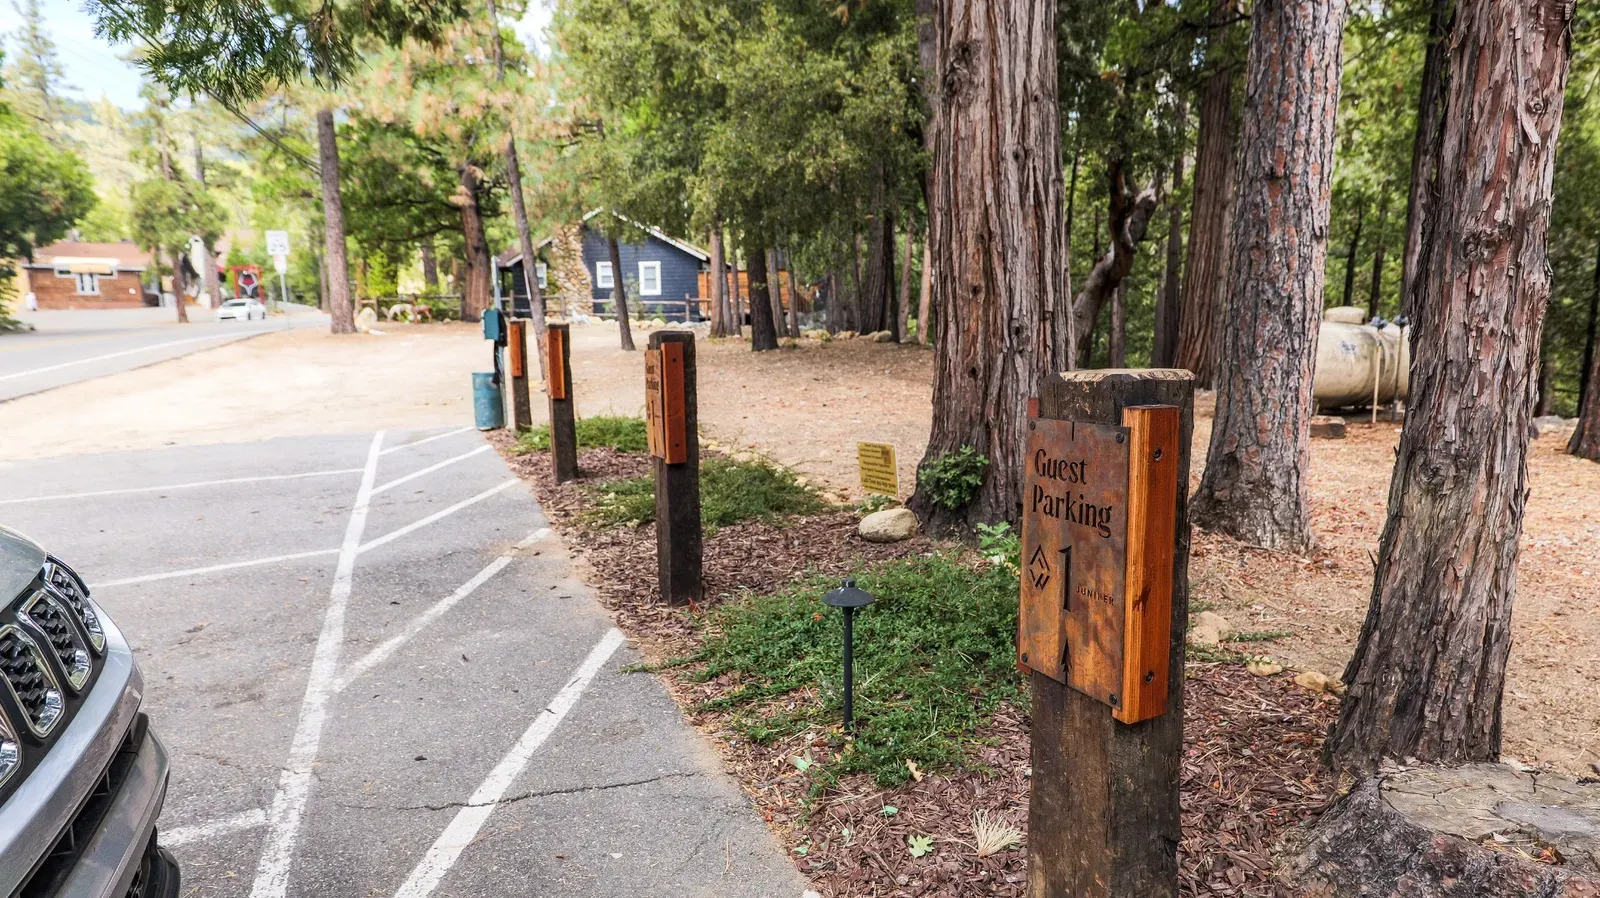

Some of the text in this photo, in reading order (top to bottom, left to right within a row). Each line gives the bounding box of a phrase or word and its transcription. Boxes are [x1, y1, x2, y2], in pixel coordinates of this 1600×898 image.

[1034, 448, 1088, 485] Guest
[1032, 484, 1112, 539] Parking
[1058, 545, 1114, 612] 1 JUNIPER
